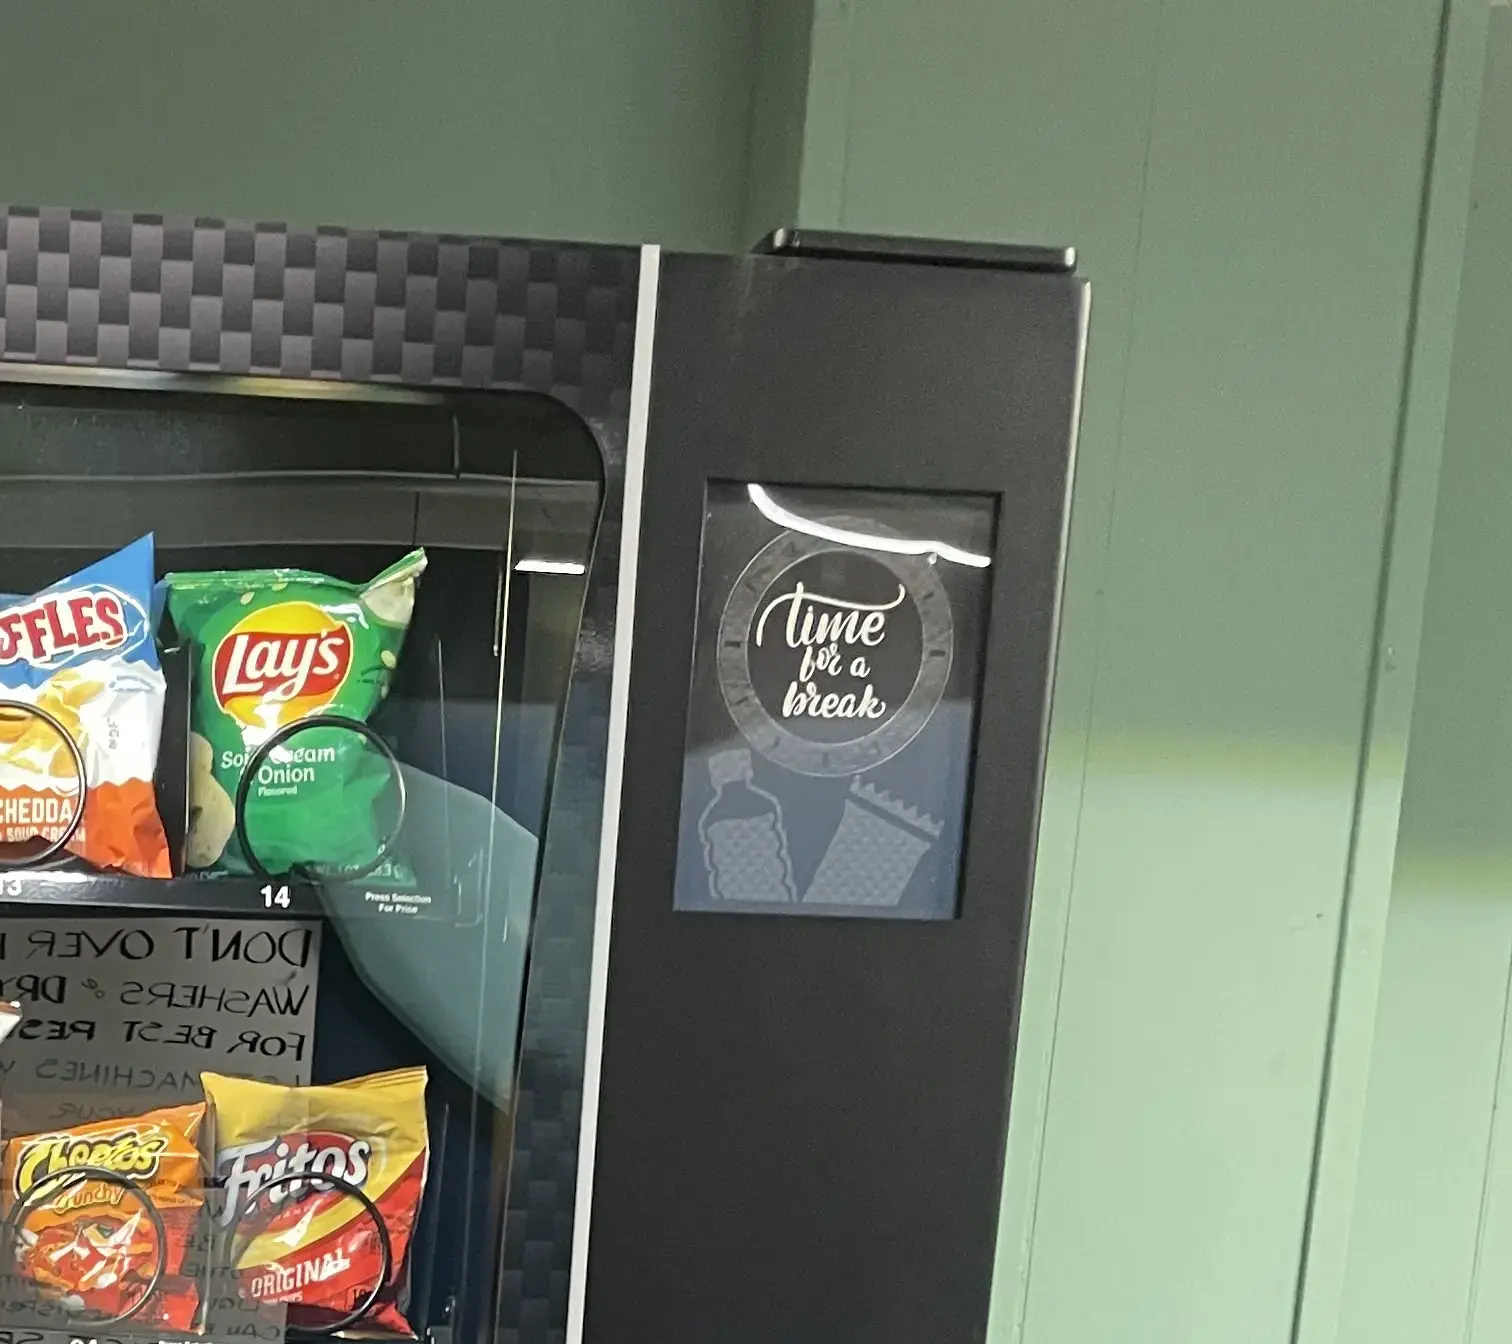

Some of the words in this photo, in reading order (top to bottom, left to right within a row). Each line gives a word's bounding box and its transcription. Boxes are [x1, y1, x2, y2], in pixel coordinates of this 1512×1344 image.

[222, 631, 345, 702] Lay's
[799, 643, 843, 682] for
[850, 654, 871, 679] a
[782, 680, 887, 719] break
[257, 765, 316, 785] Onion
[260, 883, 291, 909] 14
[18, 1131, 167, 1207] Cheetos
[216, 1136, 371, 1228] Fritos
[251, 1247, 352, 1298] ORIGINAL
